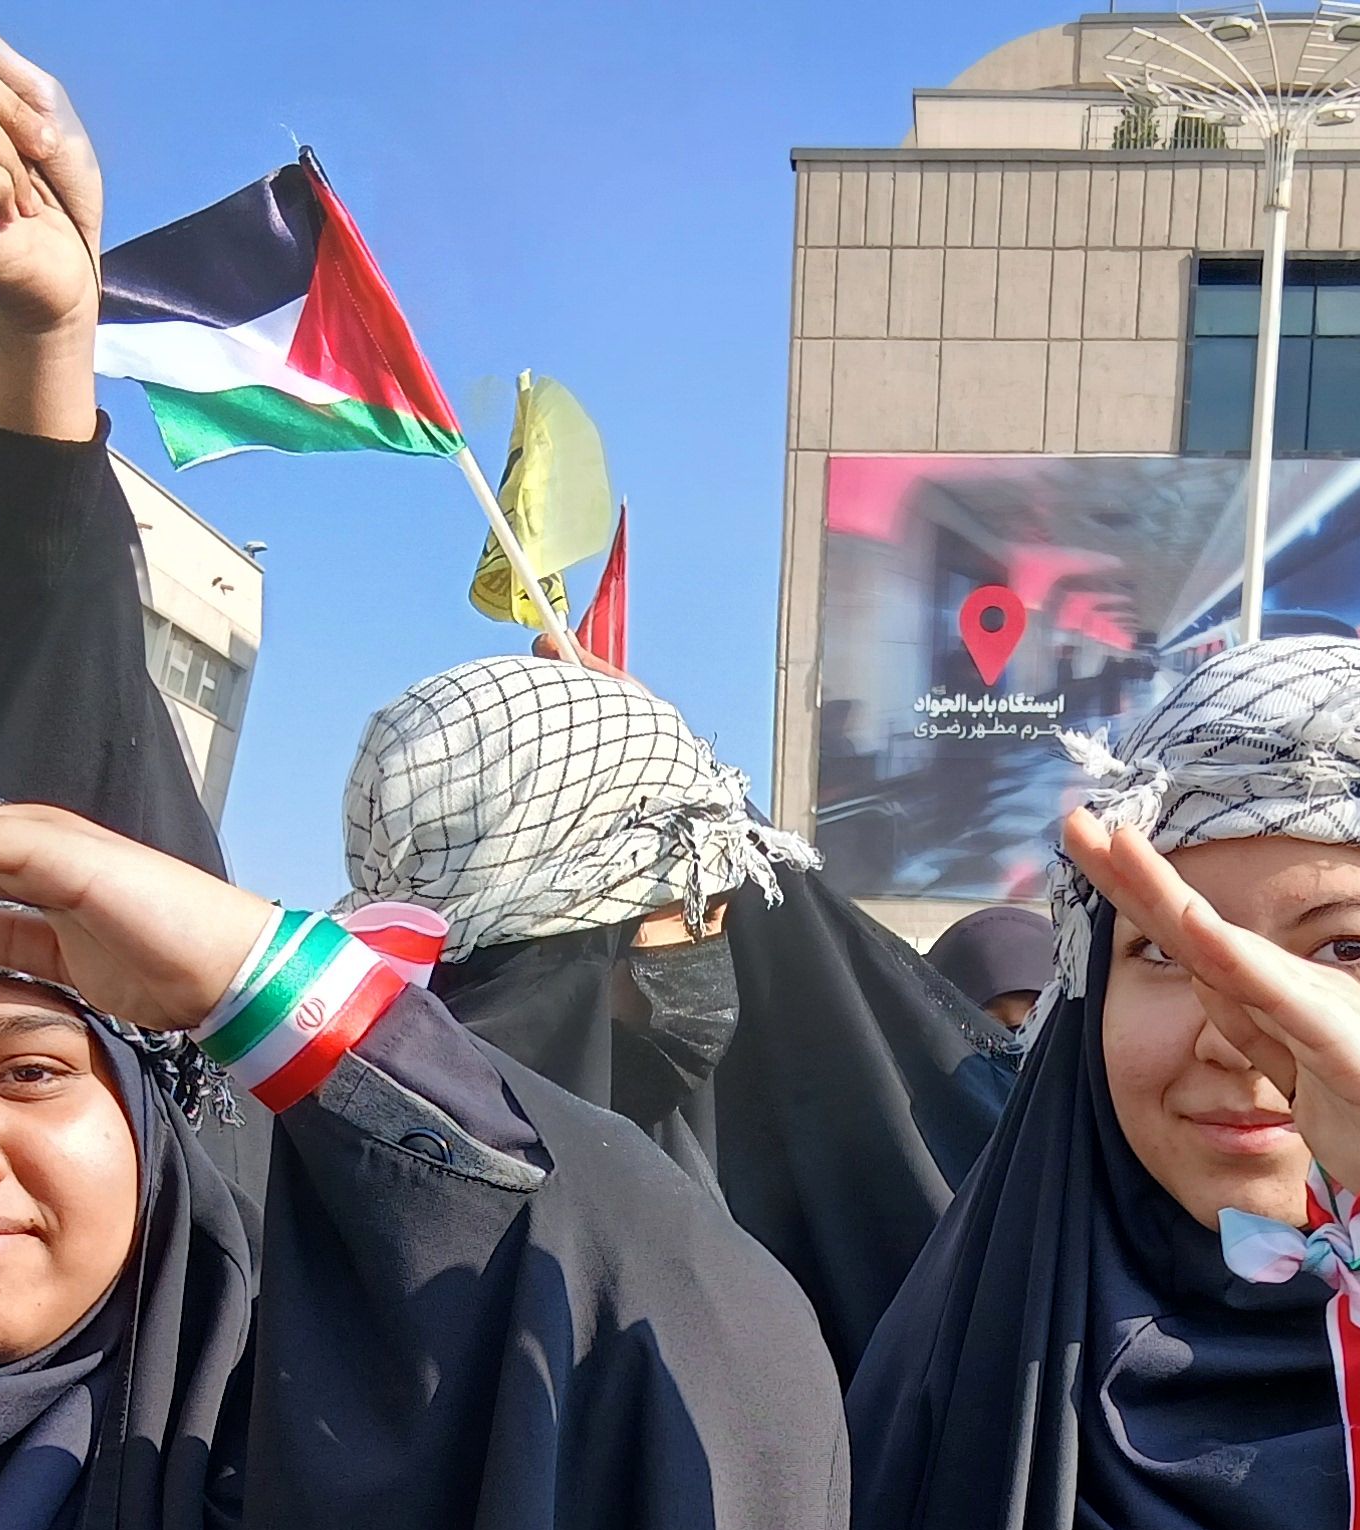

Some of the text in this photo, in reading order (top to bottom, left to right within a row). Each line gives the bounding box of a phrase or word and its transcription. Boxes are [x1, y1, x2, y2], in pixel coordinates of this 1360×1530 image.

[913, 692, 1066, 720] ایستگاه باب الجواد
[913, 717, 1063, 741] حرم مطهر رضوی
